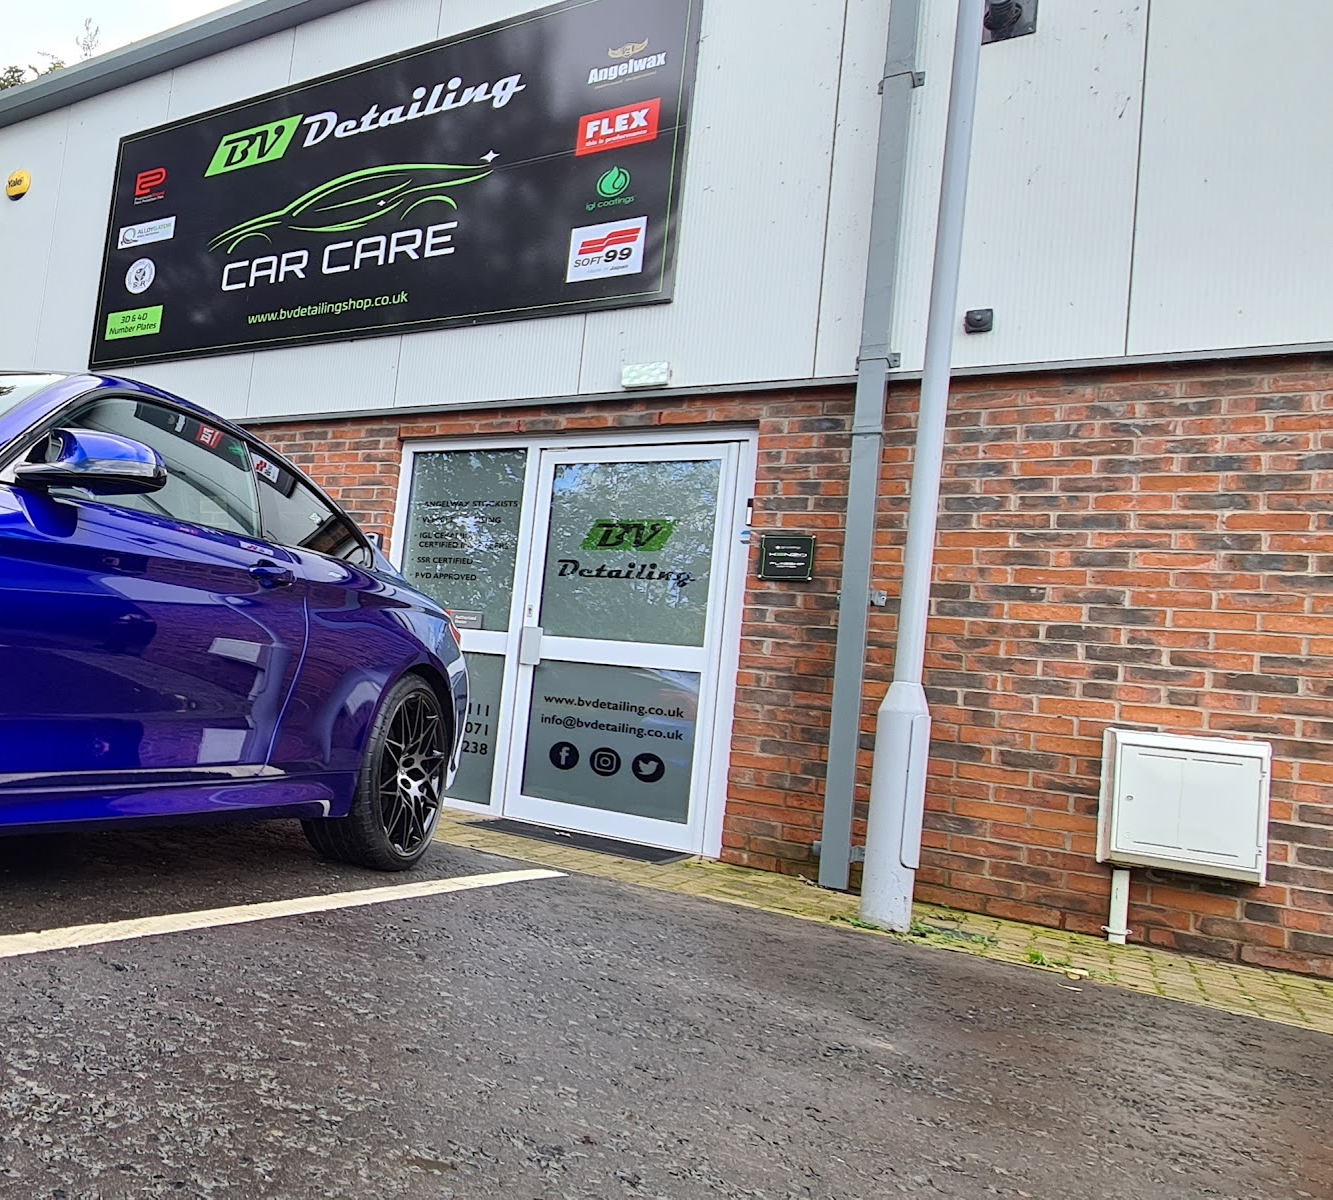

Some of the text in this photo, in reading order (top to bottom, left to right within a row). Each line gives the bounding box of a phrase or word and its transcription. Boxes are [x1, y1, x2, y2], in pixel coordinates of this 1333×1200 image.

[587, 52, 667, 85] Angelwax
[223, 74, 527, 168] BV Detailing
[585, 108, 651, 140] FLEX
[8, 177, 23, 189] Yale
[597, 195, 635, 208] coatings
[221, 221, 459, 292] CAR CARE
[120, 315, 131, 324] 3D
[137, 312, 148, 321] 4D
[247, 290, 409, 325] www.bvdetailingshop.co.uk
[108, 322, 157, 336] Number Plates
[418, 541, 459, 549] CERTIFIED
[597, 523, 664, 548] BV
[416, 556, 474, 565] SSR CERTIFIED
[432, 572, 477, 581] APPROVED
[557, 559, 696, 588] Detailing
[543, 695, 685, 719] www.bvdetailing.co.uk
[540, 714, 684, 741] info@bvdetailing.co.uk
[462, 740, 488, 755] 238
